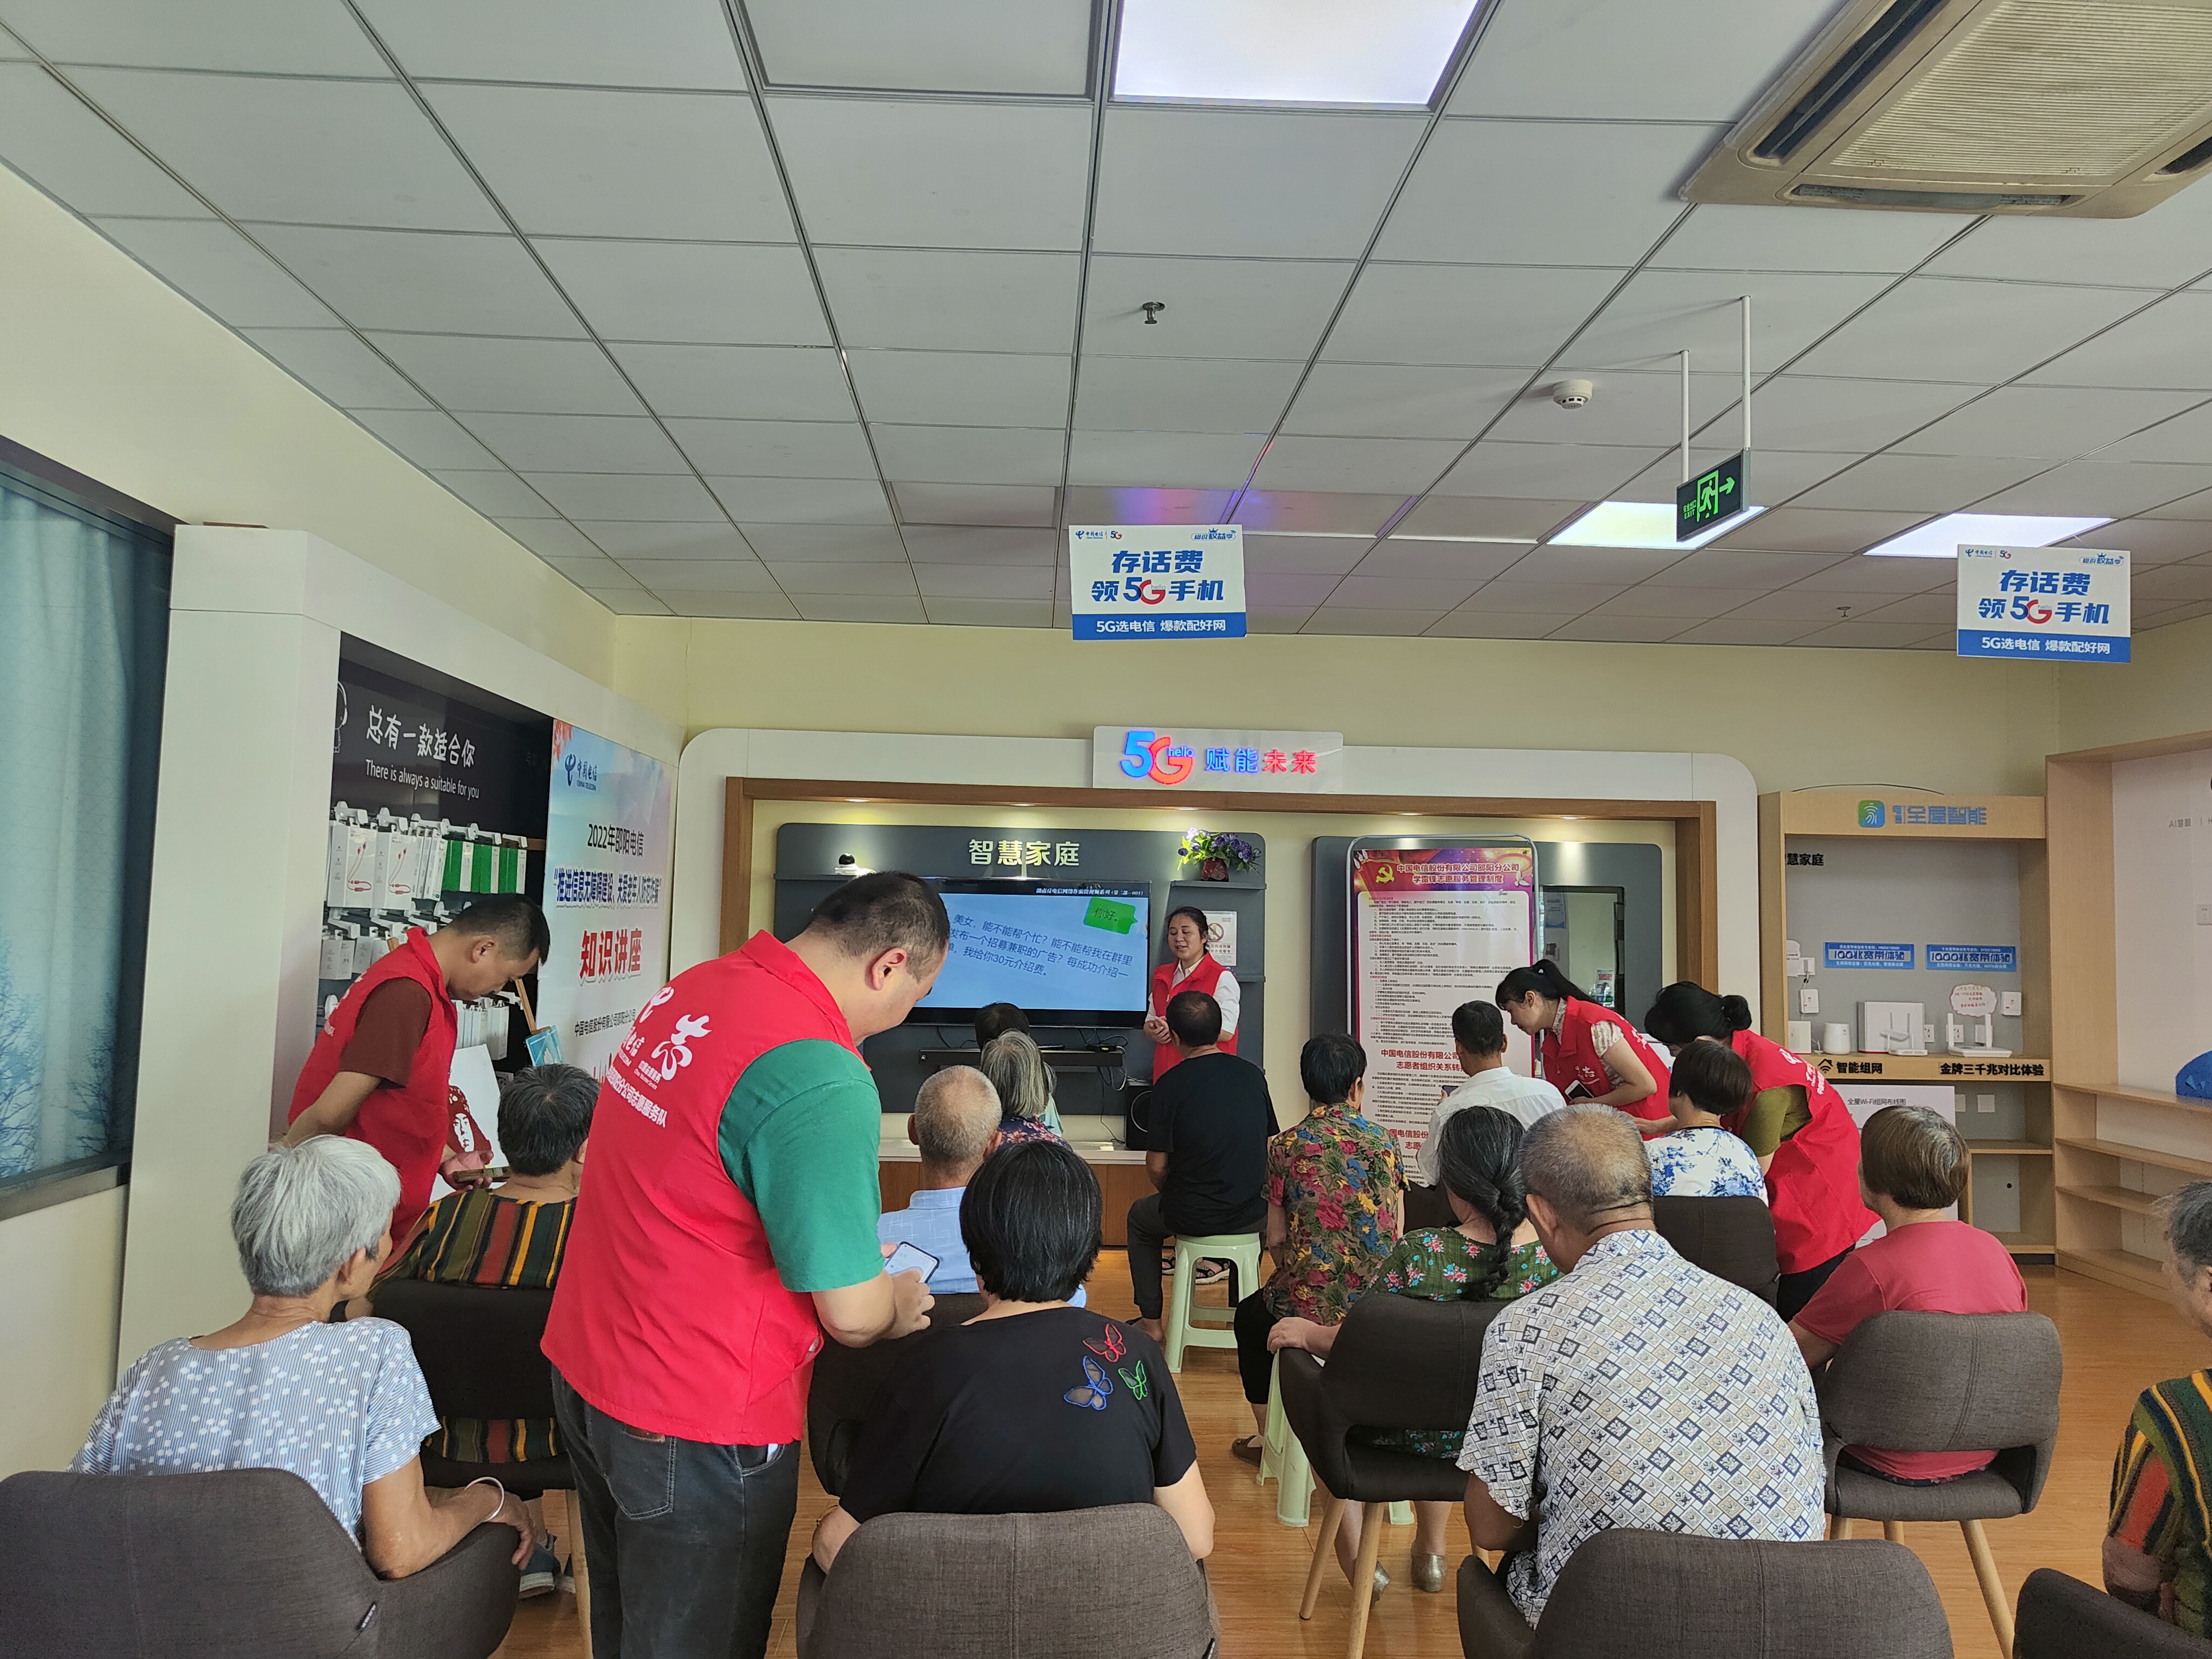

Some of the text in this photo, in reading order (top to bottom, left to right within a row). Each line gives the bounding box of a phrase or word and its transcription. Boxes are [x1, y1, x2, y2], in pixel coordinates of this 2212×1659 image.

[1684, 509, 1695, 520] EXIT
[1110, 530, 1122, 539] 5G
[1111, 550, 1203, 574] 存话费
[1999, 550, 2012, 559] 5G
[1091, 577, 1224, 605] 领5G手机
[1999, 570, 2091, 596] 存话费
[1978, 596, 2109, 624] 领5G手机
[1096, 619, 1226, 633] 5G选电信 爆款配好网
[1981, 637, 2110, 655] 5G选电信 爆款配好网
[366, 705, 475, 768] 总有一款适合你
[1119, 730, 1195, 785] 5G
[1167, 745, 1195, 758] hello
[1205, 747, 1318, 774] 赋能未来
[577, 758, 598, 782] 中国电信
[366, 759, 480, 801] There is always a suitable for you
[1907, 805, 1987, 826] 全屋智能
[587, 824, 645, 858] 2022年邵阳电信
[968, 839, 1080, 867] 智慧家庭
[1785, 853, 1824, 866] 慧家庭
[1397, 864, 1520, 873] 中国电信股份有限公司邵阳分公司
[1412, 875, 1504, 884] 学雷锋志愿服务管理制度
[579, 928, 642, 979] 知识讲座
[1834, 950, 1905, 961] 100兆宽带体验
[1932, 952, 2011, 963] 1000兆宽带体验
[1381, 1049, 1460, 1061] 中国电信股份有限公司
[1396, 1061, 1464, 1072] 志愿者组织关系转
[1837, 1061, 1883, 1074] 智能组网
[1940, 1063, 2045, 1076] 金牌三千兆对比体验
